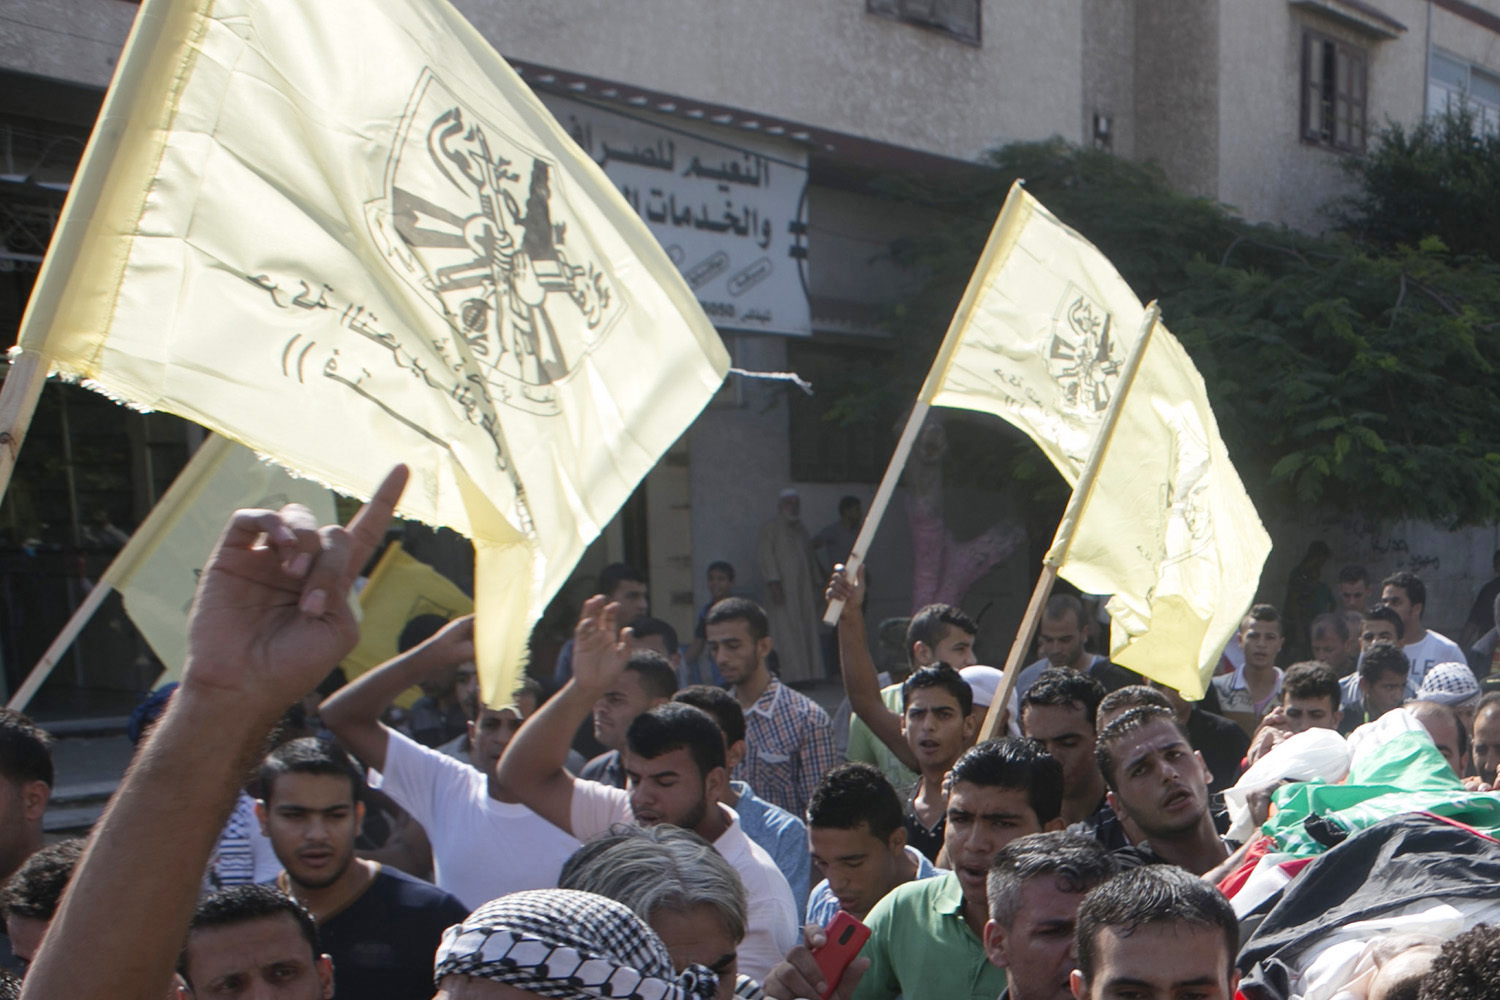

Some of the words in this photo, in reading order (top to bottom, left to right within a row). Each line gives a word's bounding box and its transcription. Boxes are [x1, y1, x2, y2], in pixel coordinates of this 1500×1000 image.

[567, 114, 676, 173] للصراف
[681, 153, 770, 191] النعيم
[646, 186, 772, 249] والخدمات
